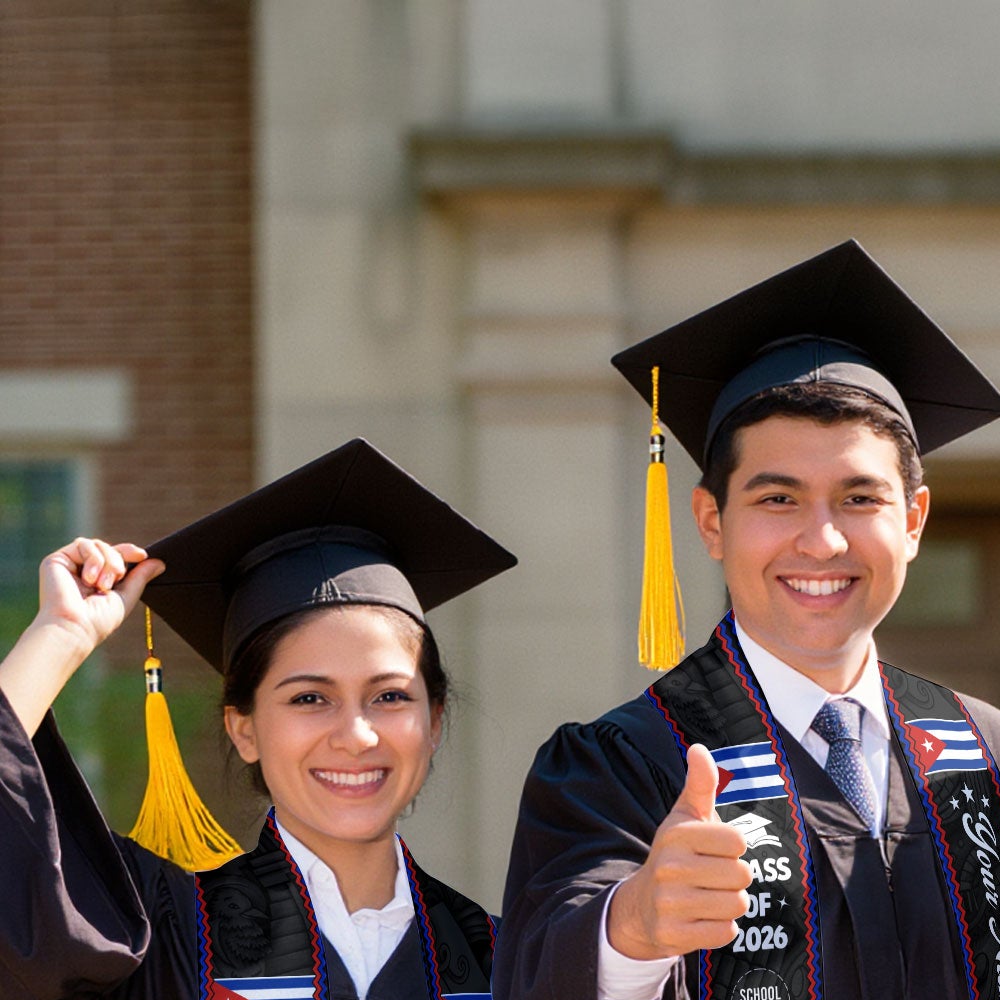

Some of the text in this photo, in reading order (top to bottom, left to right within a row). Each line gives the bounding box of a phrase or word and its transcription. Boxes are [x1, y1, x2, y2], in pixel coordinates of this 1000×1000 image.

[749, 856, 792, 883] ASS
[962, 811, 1000, 909] Your
[745, 892, 771, 919] OF
[732, 925, 788, 953] 2026
